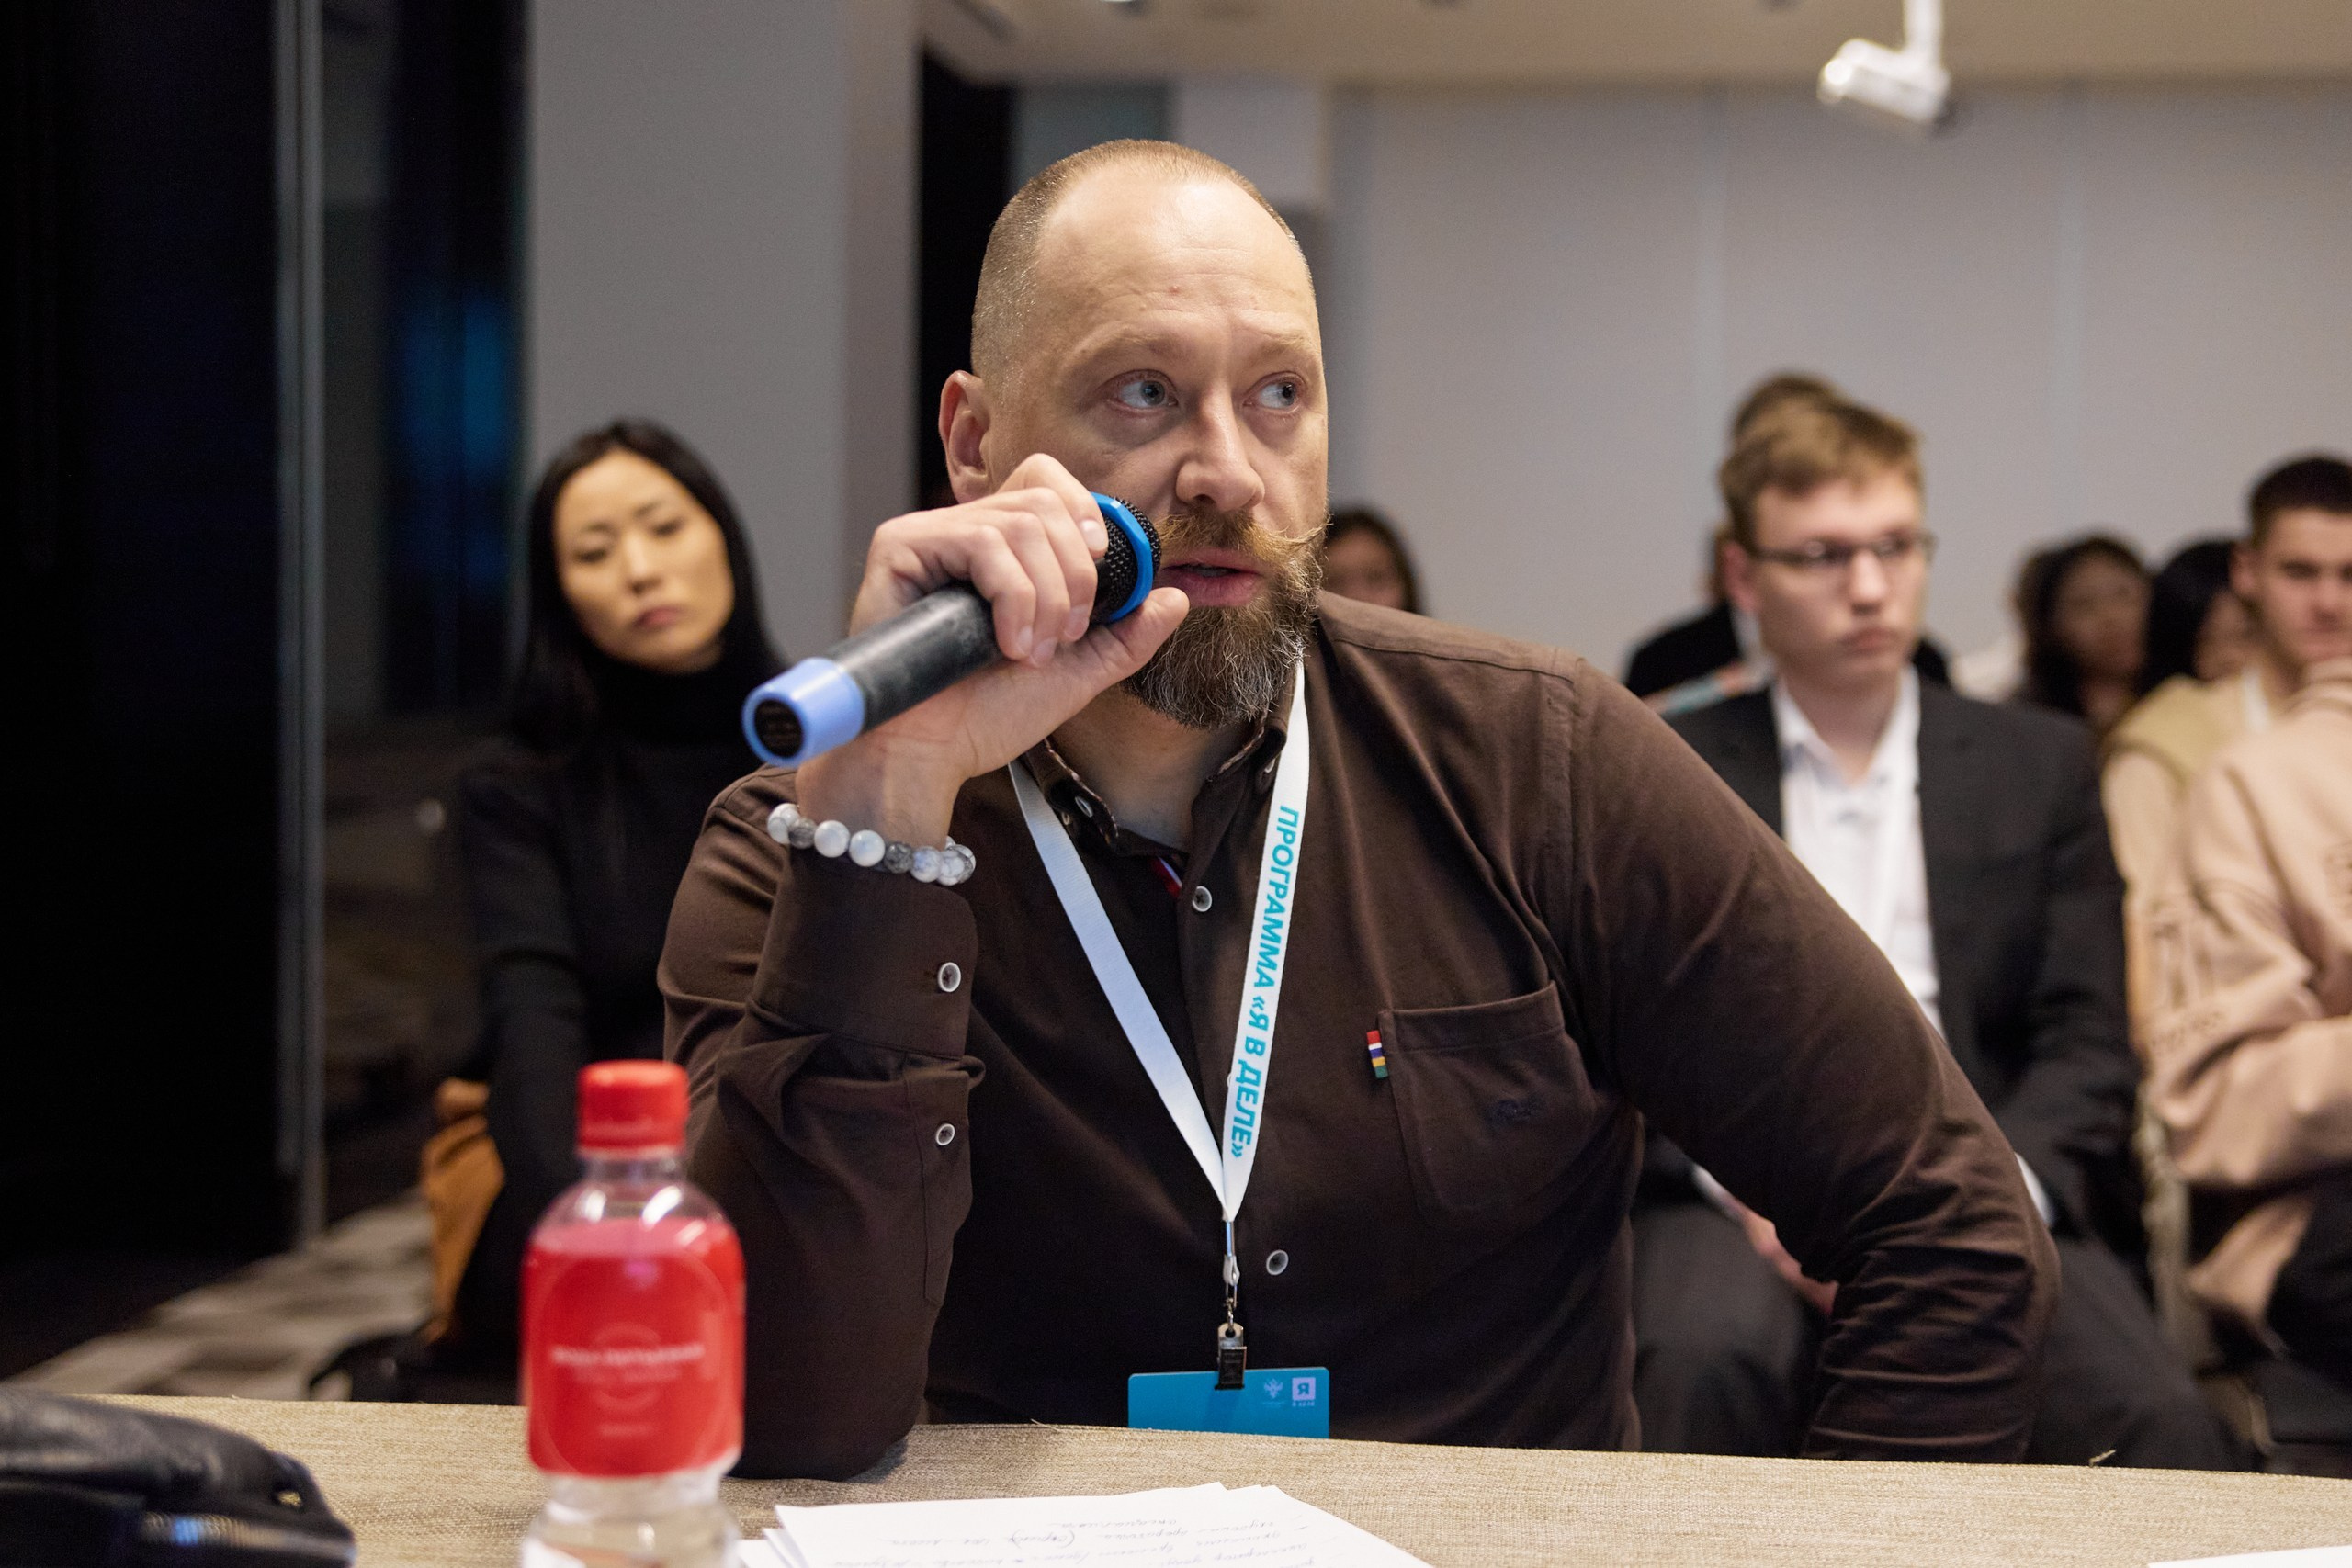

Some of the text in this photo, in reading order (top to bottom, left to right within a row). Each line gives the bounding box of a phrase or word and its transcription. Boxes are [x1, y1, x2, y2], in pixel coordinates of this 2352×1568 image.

[1231, 805, 1299, 1158] ПРОГРАММА «Я В ДЕЛЕ»
[1297, 1382, 1309, 1395] Я
